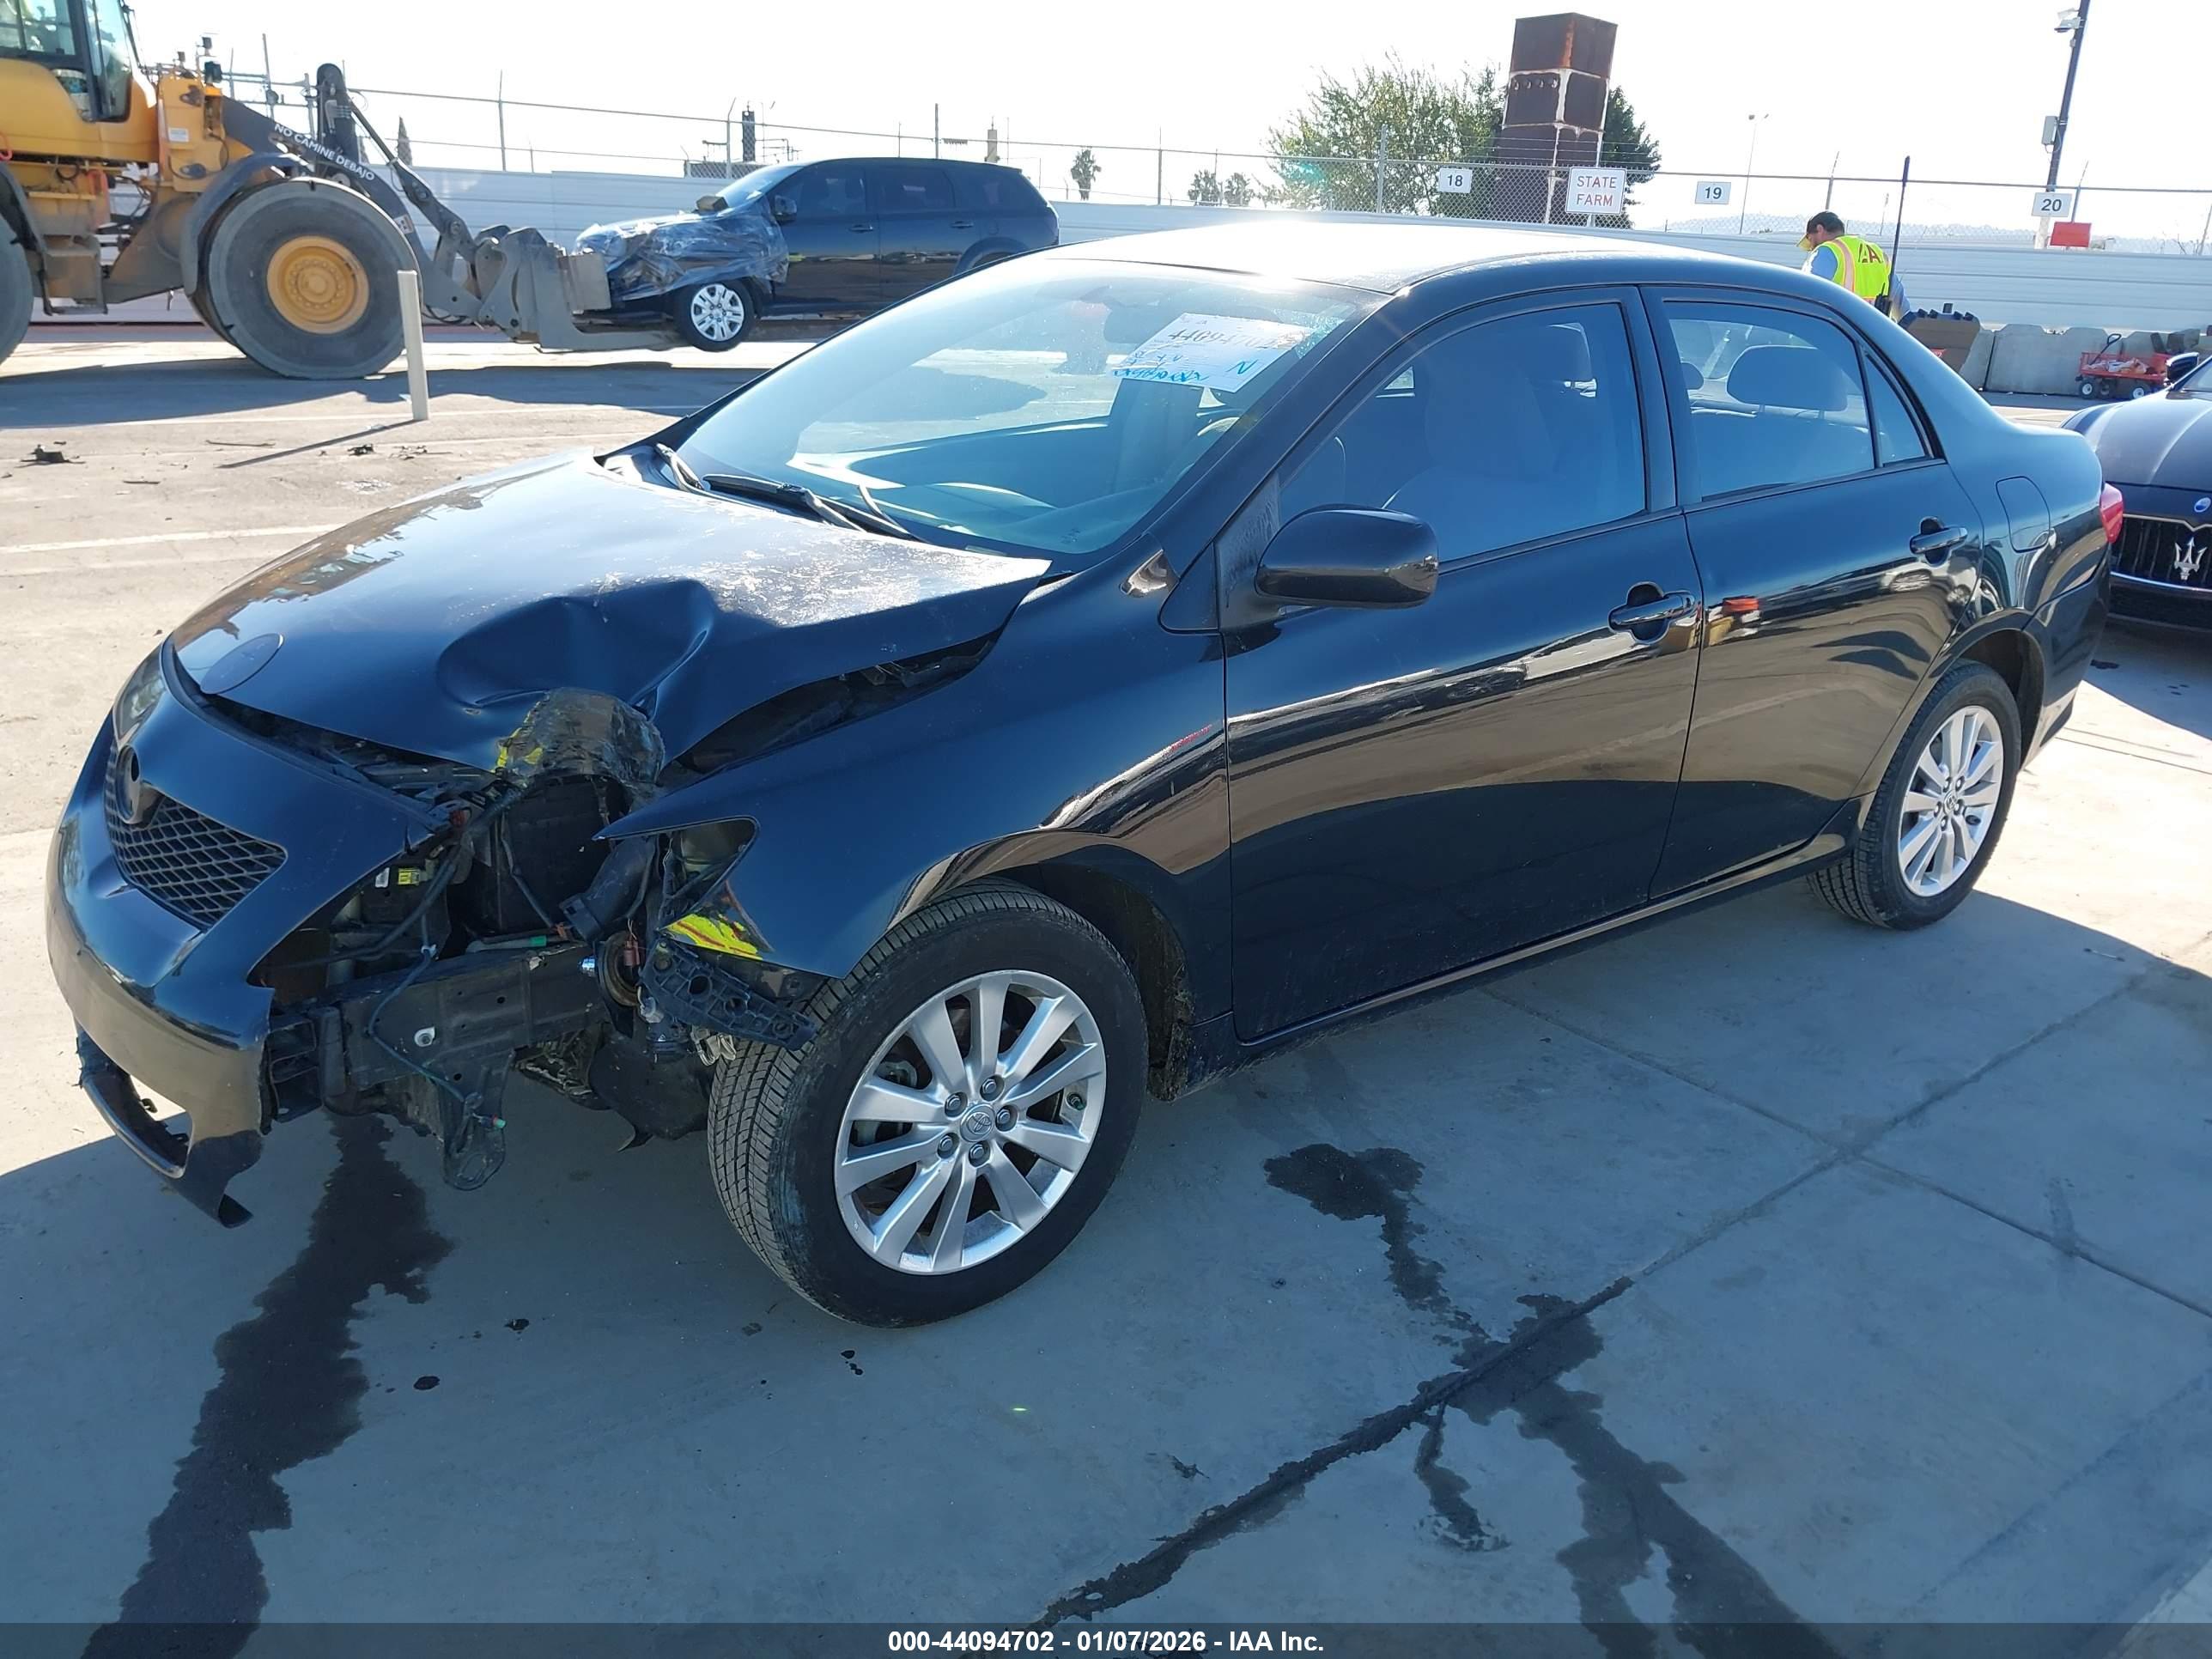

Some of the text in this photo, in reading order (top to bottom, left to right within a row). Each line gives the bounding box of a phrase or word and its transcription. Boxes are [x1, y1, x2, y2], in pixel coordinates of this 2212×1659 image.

[275, 124, 375, 180] NO CAMINE DEBAJO
[1447, 174, 1463, 187] 18
[1577, 175, 1617, 189] STATE
[1705, 186, 1723, 200] 19
[1577, 195, 1613, 207] FARM
[2040, 198, 2063, 212] 20
[1227, 359, 1259, 375] N
